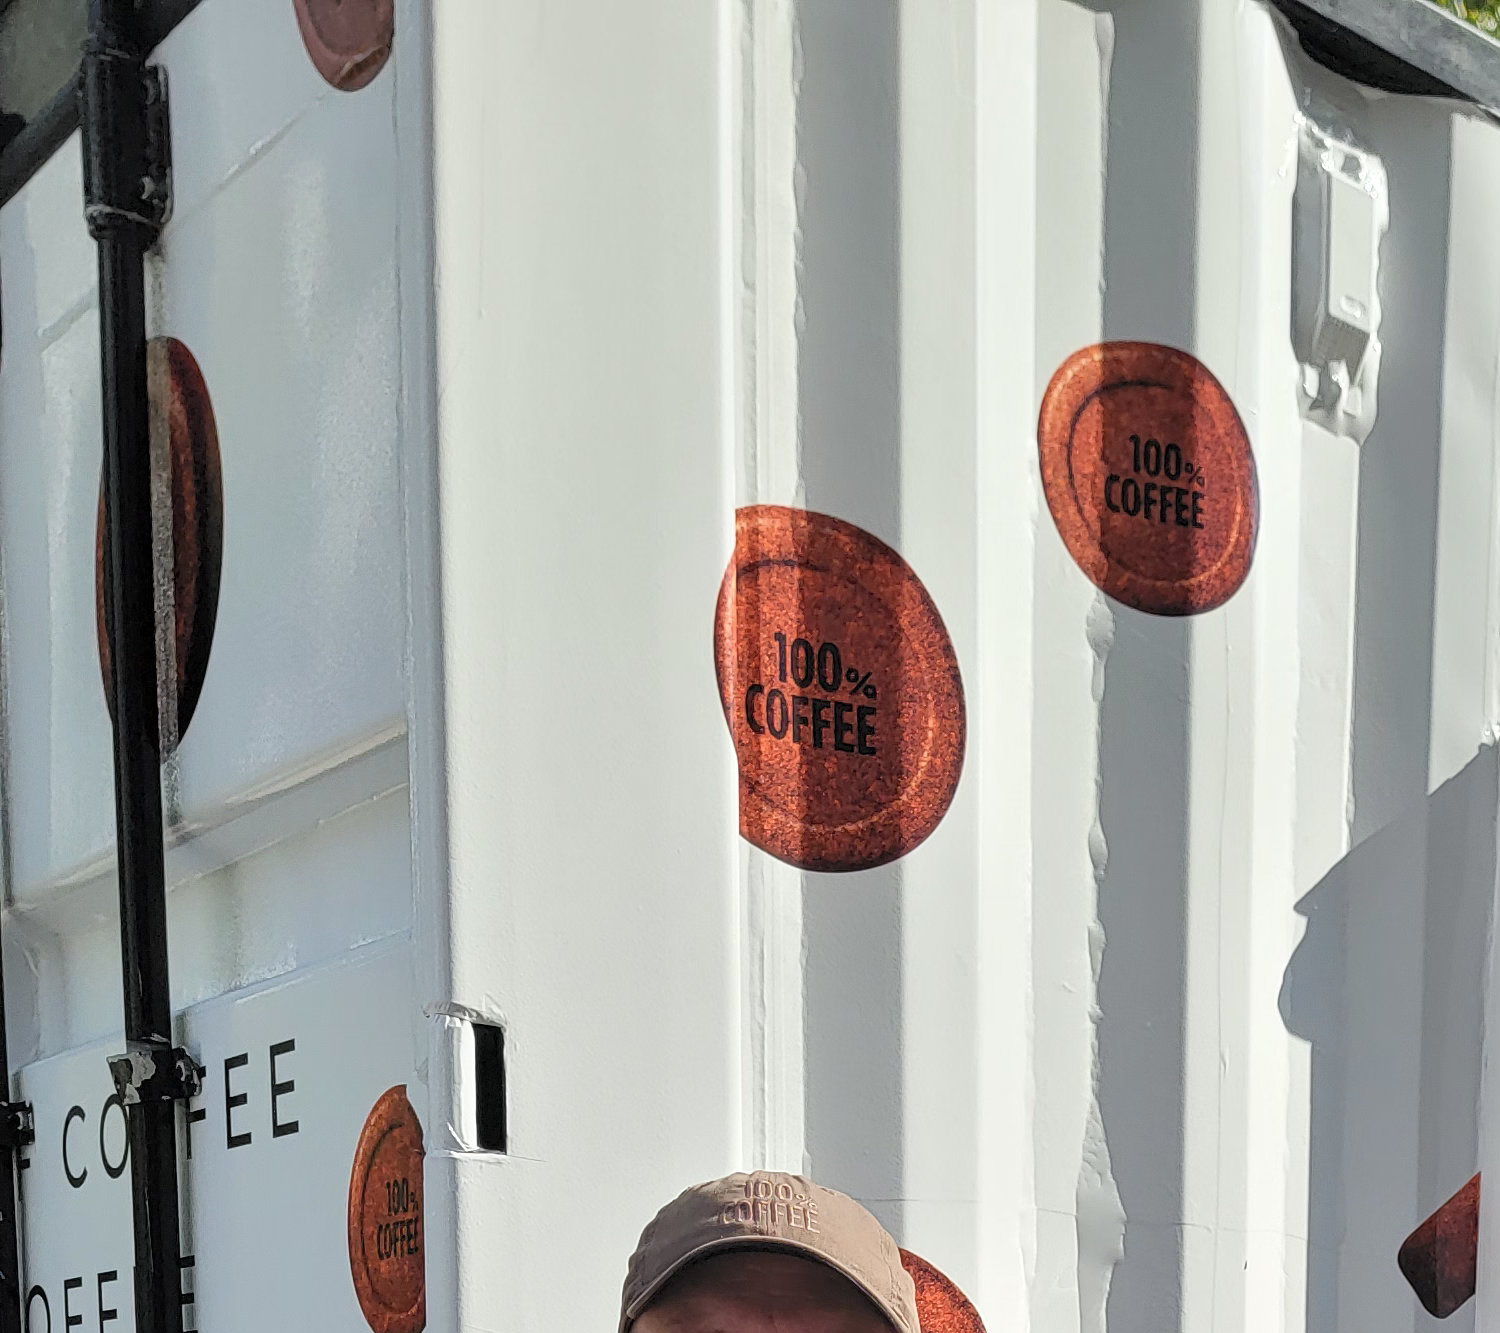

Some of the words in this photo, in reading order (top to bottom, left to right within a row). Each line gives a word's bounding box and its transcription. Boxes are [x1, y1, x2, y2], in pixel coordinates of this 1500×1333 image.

[1129, 434, 1205, 487] 100%
[1104, 472, 1204, 529] COFFEE
[774, 632, 877, 699] 100%
[746, 684, 877, 756] COFFEE
[63, 1038, 299, 1188] COFEE
[721, 1199, 820, 1233] COFFEE
[744, 1180, 818, 1208] 100%
[377, 1216, 419, 1260] COFFEE
